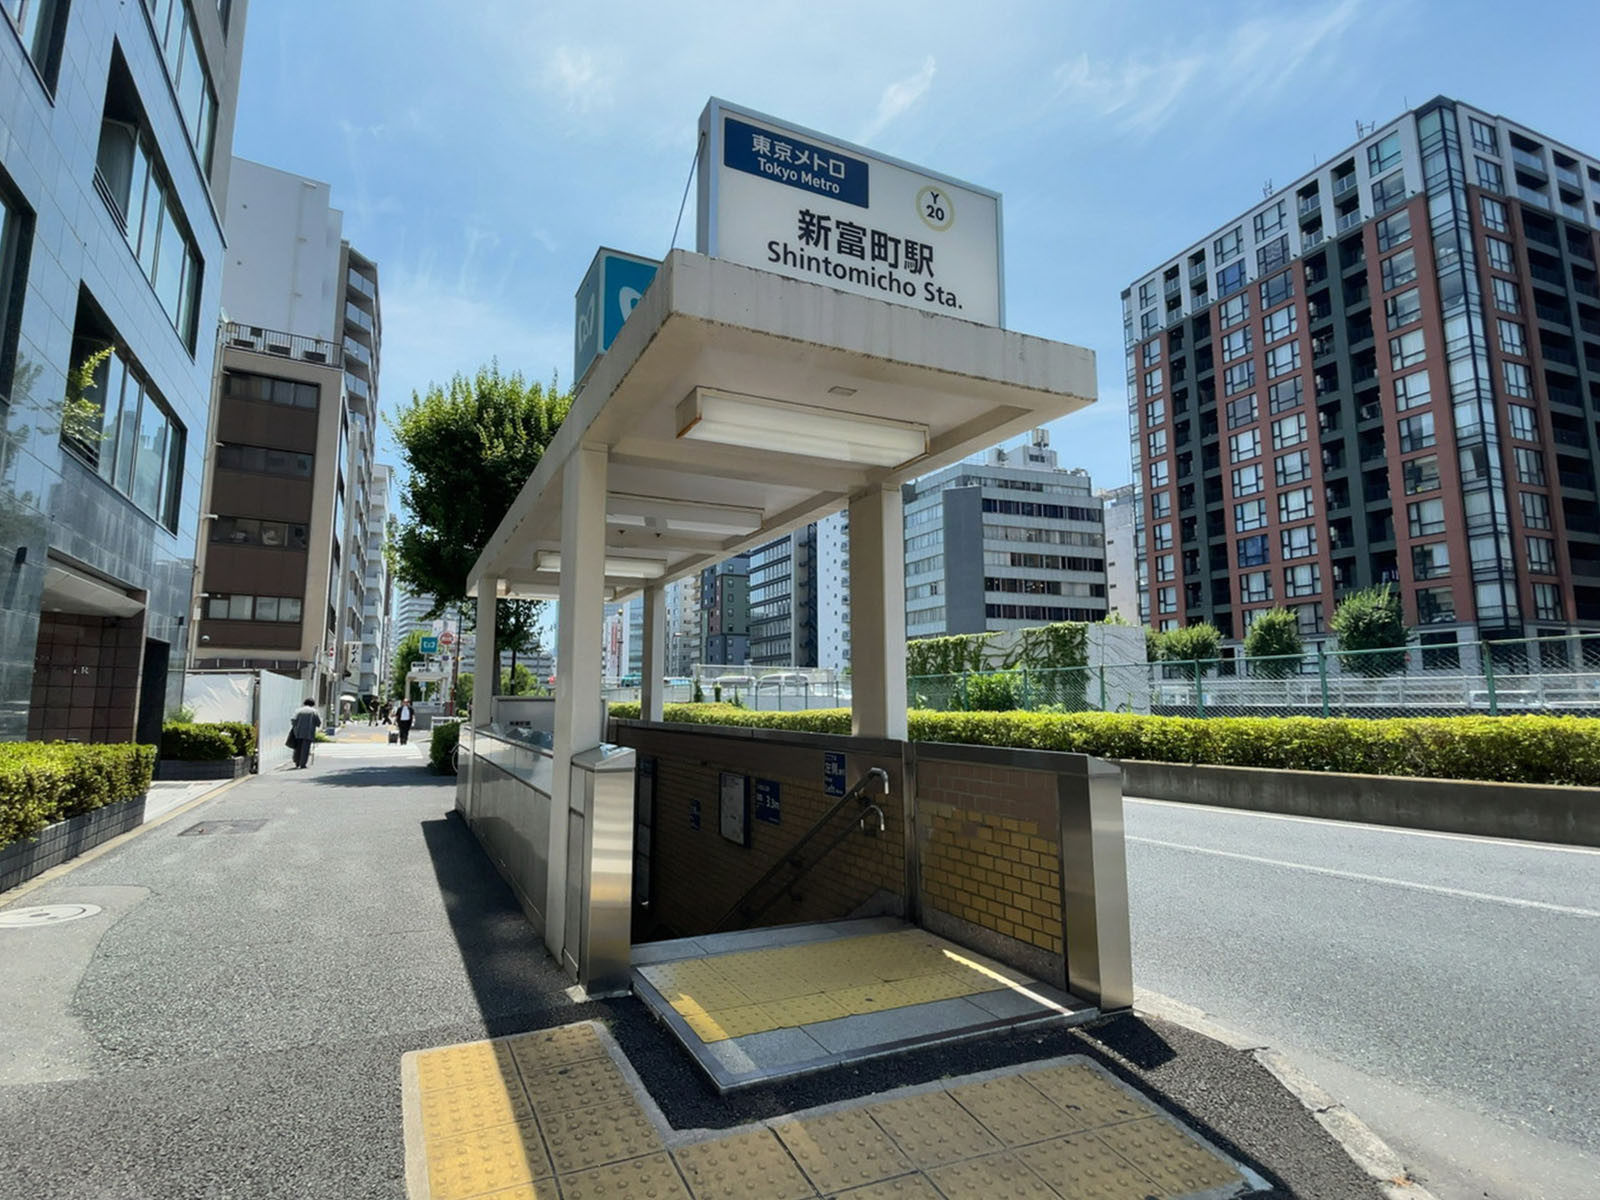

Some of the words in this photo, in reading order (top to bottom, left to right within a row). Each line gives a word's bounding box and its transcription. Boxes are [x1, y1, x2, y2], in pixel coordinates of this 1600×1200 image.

[752, 133, 845, 179] 東京メトロ
[757, 157, 798, 181] Tokyo
[801, 170, 840, 194] Metro
[926, 204, 945, 222] 20
[930, 191, 940, 205] Y
[798, 208, 935, 278] 新富町駅
[767, 240, 917, 298] Shintomicho
[924, 282, 964, 310] Sta.
